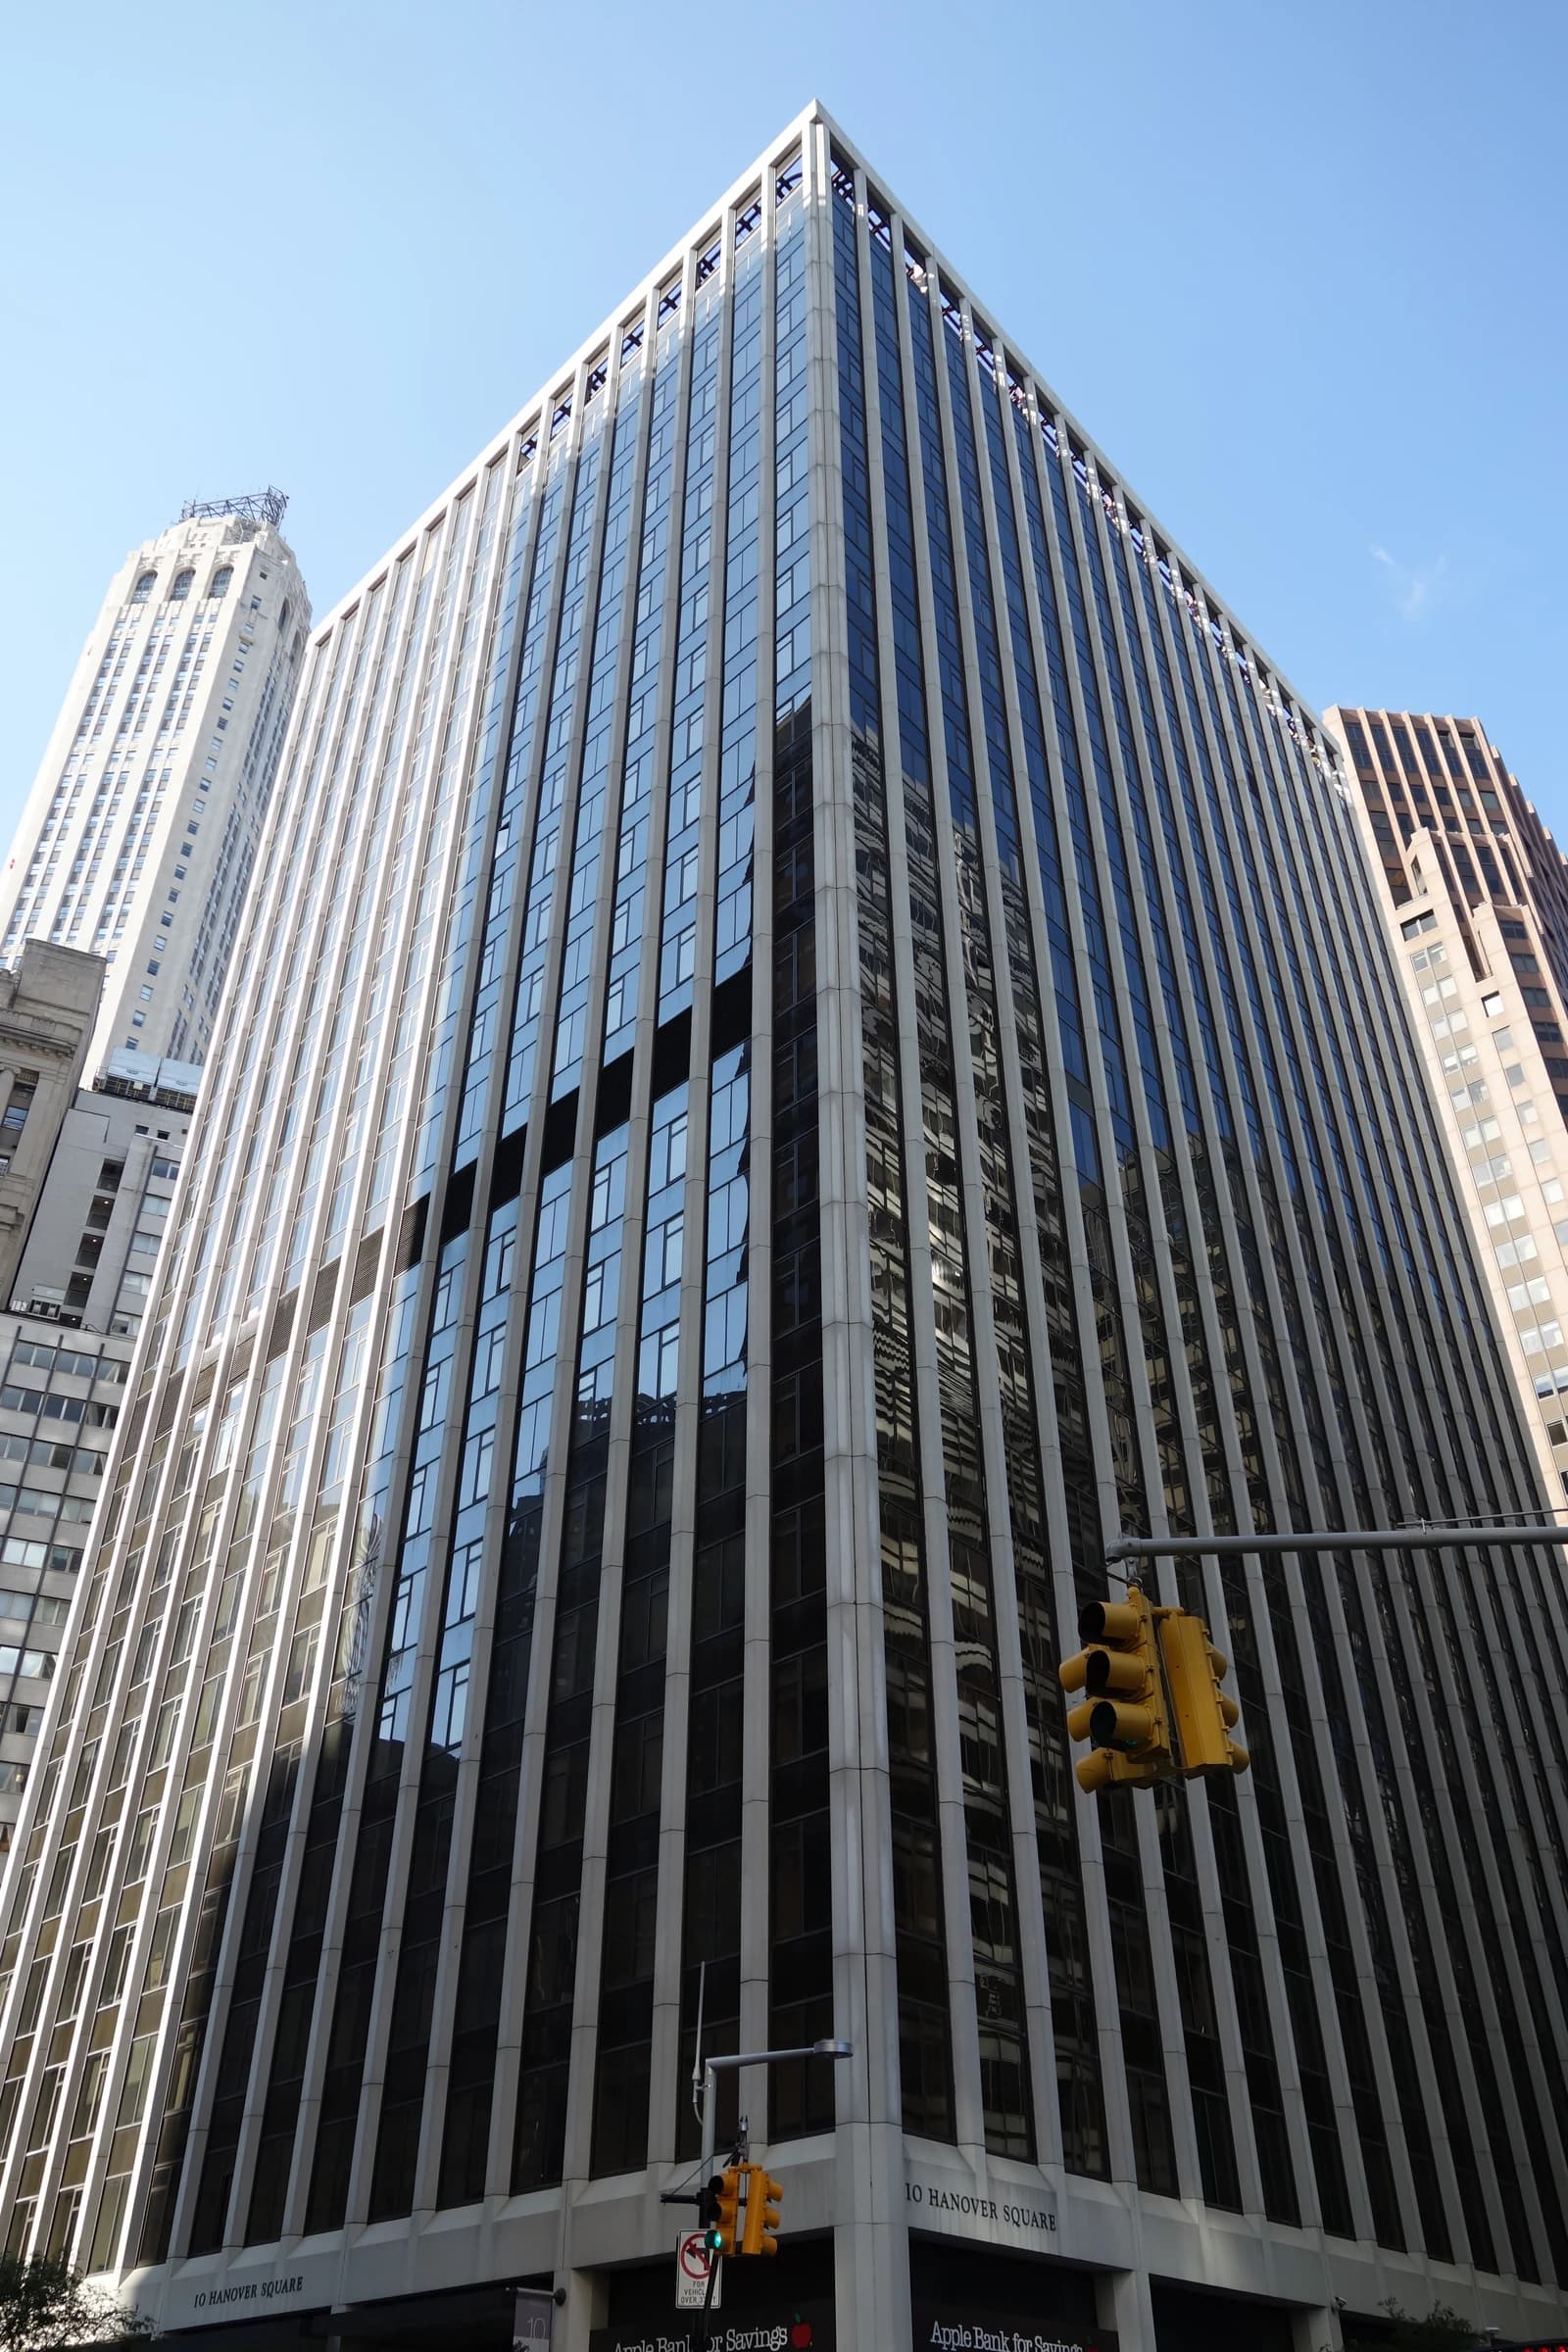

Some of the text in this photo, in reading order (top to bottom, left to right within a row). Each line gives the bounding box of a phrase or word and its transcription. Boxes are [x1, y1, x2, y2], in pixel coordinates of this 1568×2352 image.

[905, 2182, 1056, 2231] 10 HANOVER SQUARE
[194, 2277, 304, 2308] 10 HANOVER SQUARE
[527, 2317, 546, 2338] 10
[726, 2326, 788, 2352] Savings
[930, 2320, 971, 2352] Apple
[972, 2326, 1010, 2352] Bank
[1012, 2332, 1034, 2352] for
